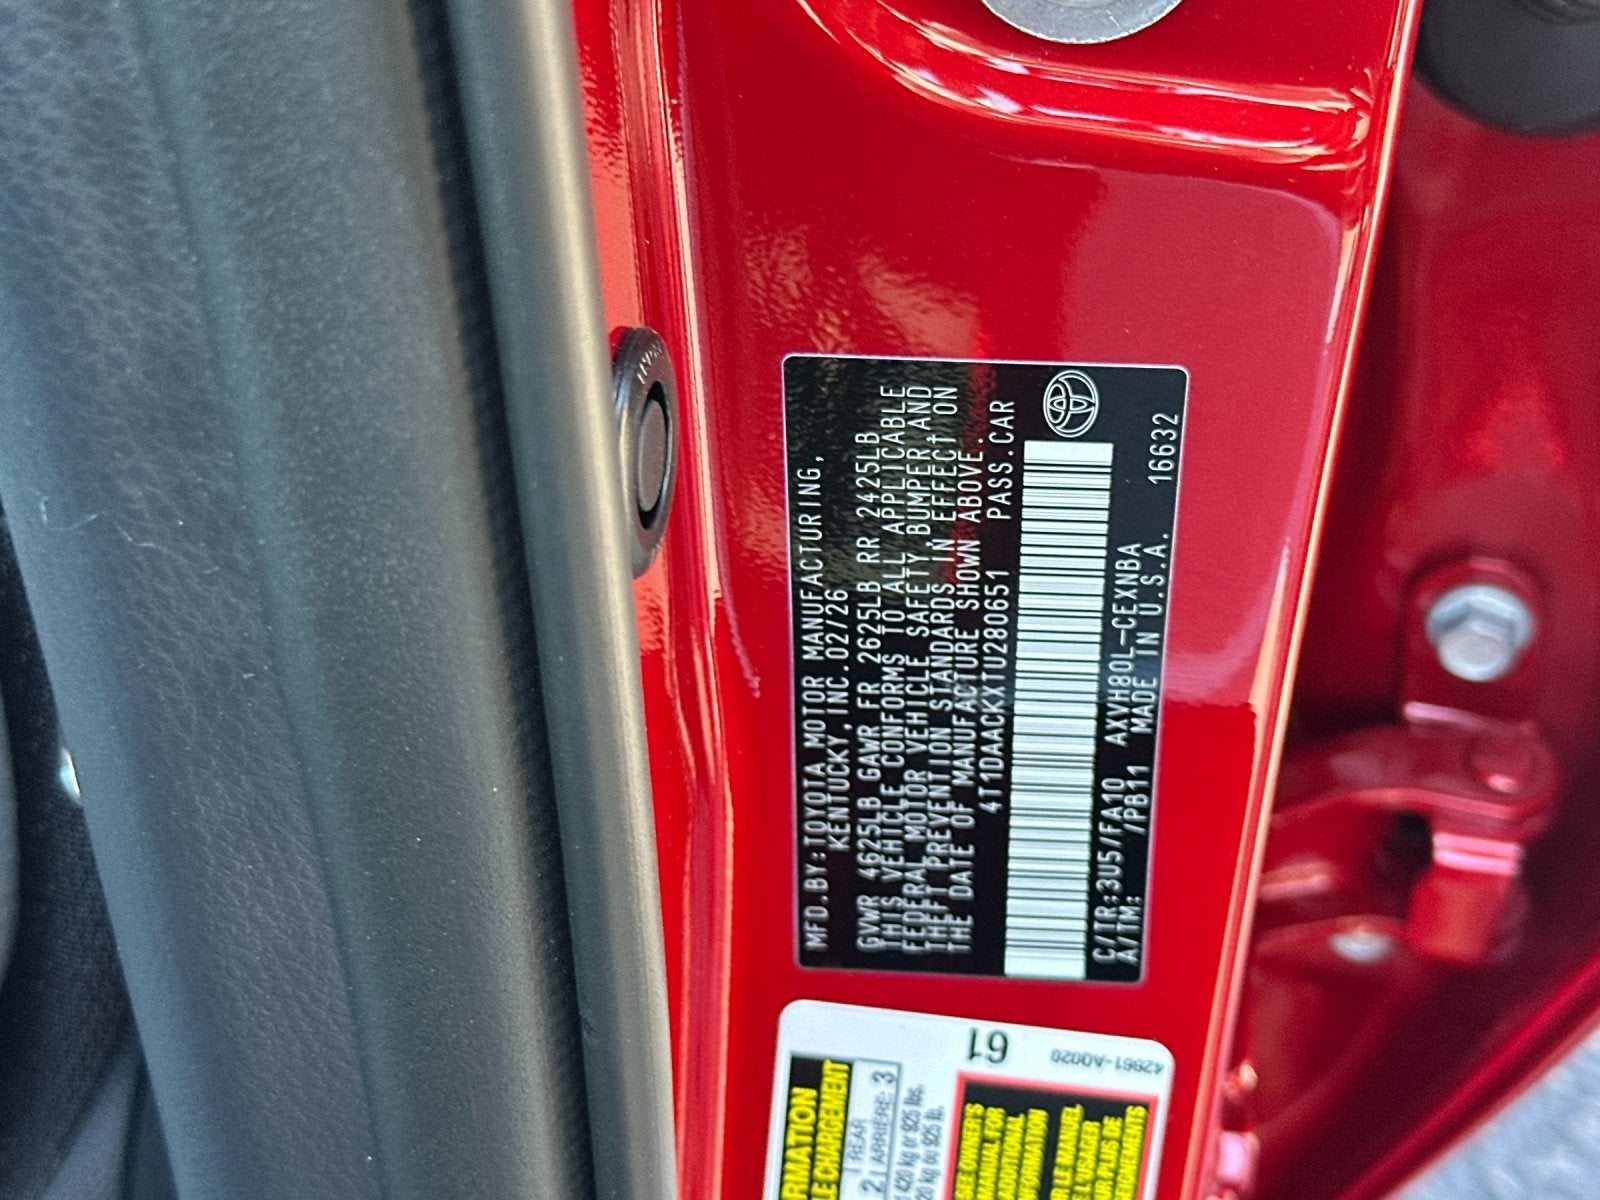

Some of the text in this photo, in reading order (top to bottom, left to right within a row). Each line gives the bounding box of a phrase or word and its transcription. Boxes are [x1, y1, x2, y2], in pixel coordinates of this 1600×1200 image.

[1148, 412, 1180, 485] 16632
[798, 455, 826, 660] MANUFACTURING,
[1139, 532, 1170, 617] U.S.A.
[979, 400, 1016, 815] 4T1DAACKXTU280651 PASS.CAR
[1104, 542, 1143, 748] AXVH80L-CEXNBA
[1135, 631, 1161, 657] IN
[801, 676, 826, 747] MOTOR
[855, 431, 882, 952] GVWR 4625LB GAWR FR 2625LB RR 2425LB
[880, 385, 906, 952] THIS VEHICLE CONFORMS TO ALL APPLICABLE
[905, 665, 931, 754] VEHICLE
[924, 386, 959, 955] THEFT PREVENTION STANDARDS IN EFFECT ON
[947, 437, 985, 956] THE DATE OF MANUFACTURE SHOWN ABOVE.
[1130, 676, 1157, 735] MADE
[904, 768, 929, 843] MOTOR
[902, 858, 928, 956] FEDERAL
[813, 1059, 850, 1182] CHARGEMENT
[872, 1071, 896, 1084] 3
[897, 1151, 921, 1167] kg
[1056, 1104, 1085, 1168] MANUEL
[861, 1179, 884, 1193] 2
